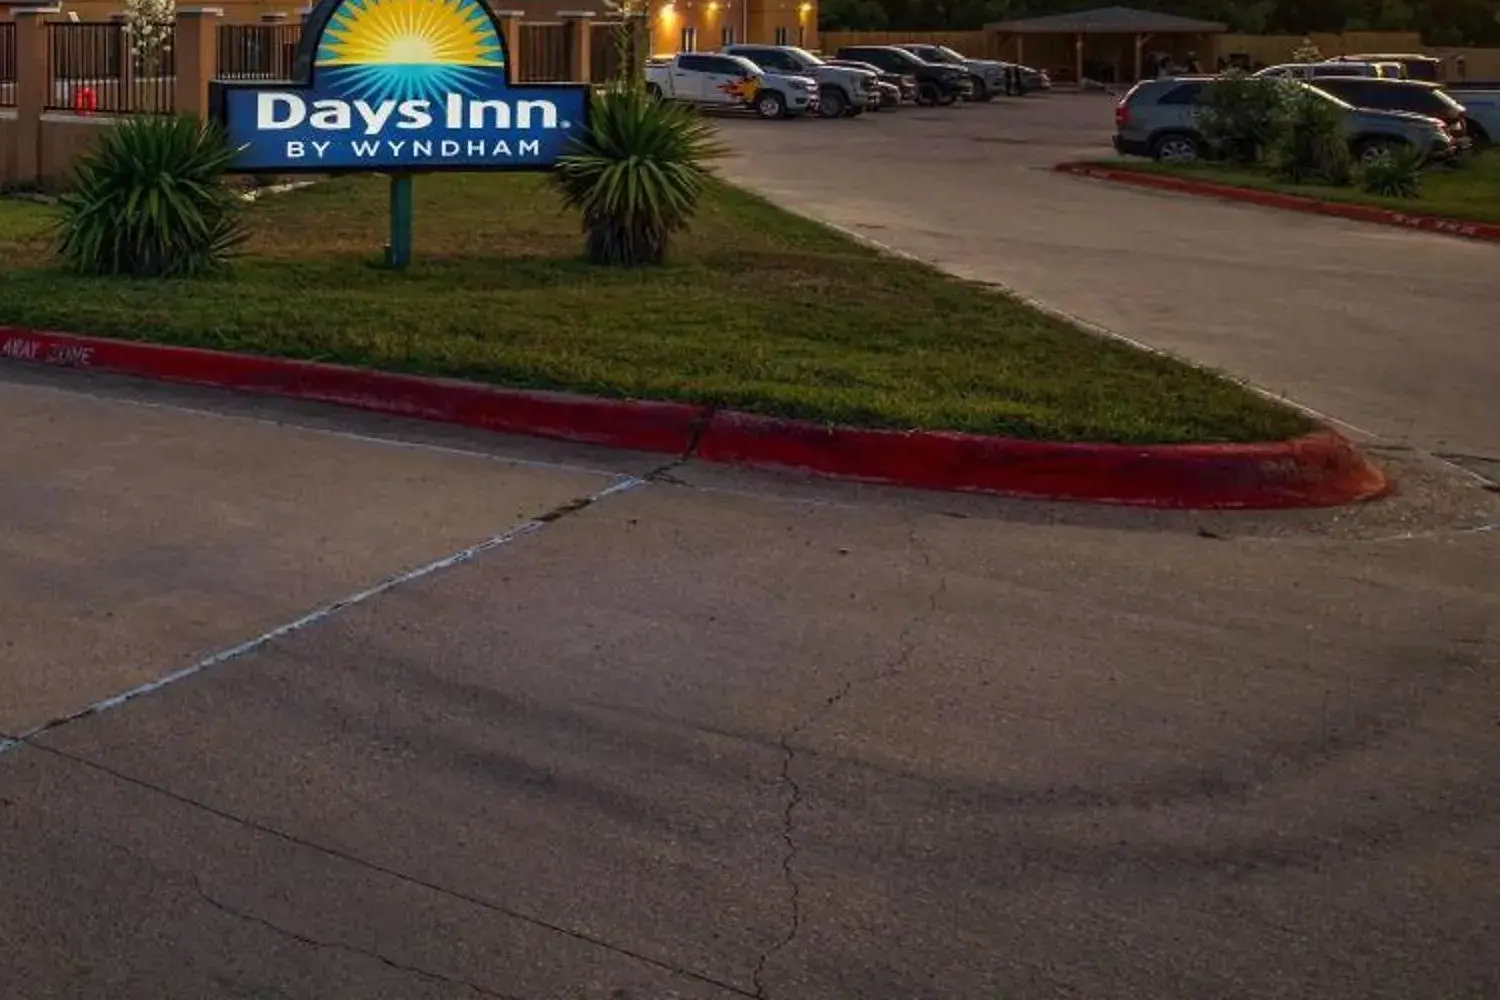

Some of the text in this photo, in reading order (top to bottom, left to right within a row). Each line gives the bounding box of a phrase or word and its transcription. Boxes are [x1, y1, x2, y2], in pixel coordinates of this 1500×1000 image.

[256, 91, 557, 134] Days Inn
[286, 139, 540, 157] BY WYNDHAM
